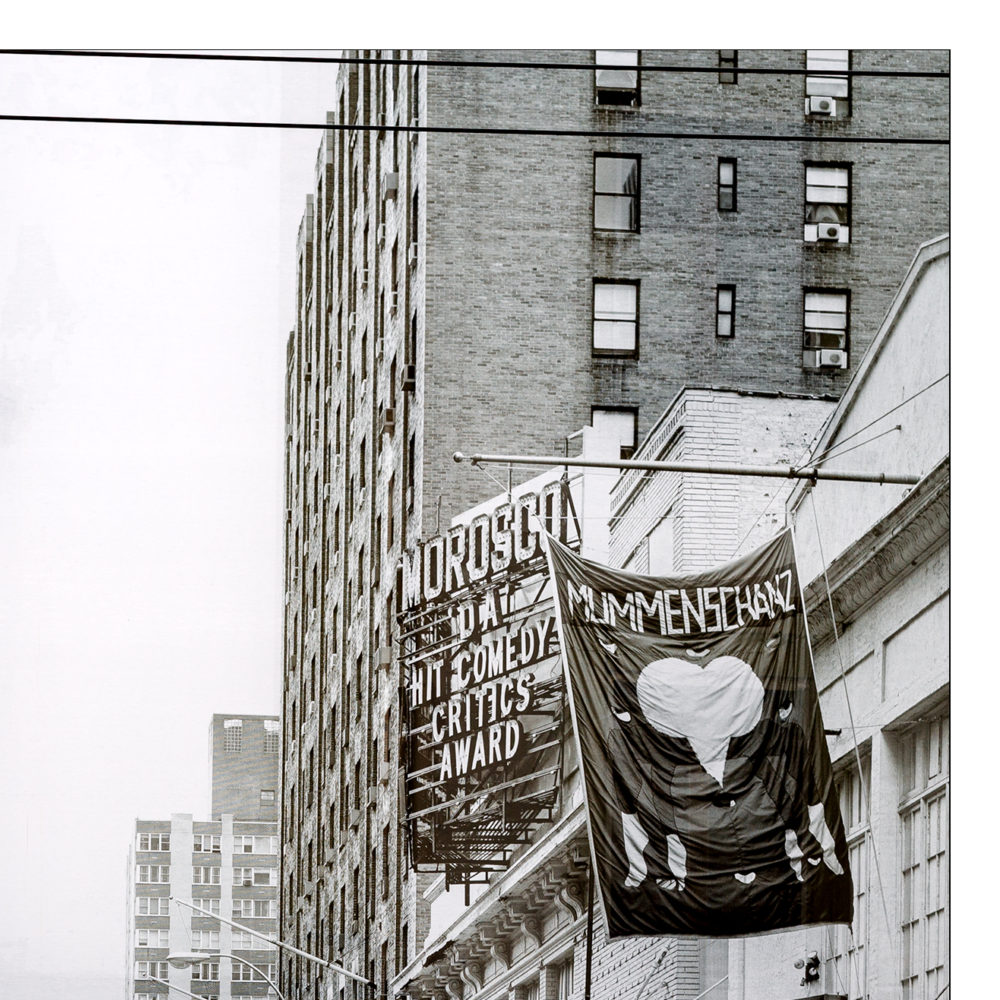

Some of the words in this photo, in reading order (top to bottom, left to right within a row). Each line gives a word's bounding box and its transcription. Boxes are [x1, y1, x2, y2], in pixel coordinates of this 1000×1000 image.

[401, 480, 562, 611] MOROSCO
[566, 568, 797, 636] MUMMENSCHANZ
[410, 659, 444, 707] HIT
[456, 617, 551, 689] COMEDY
[431, 672, 533, 743] CRITICS
[439, 719, 521, 782] AWARD
